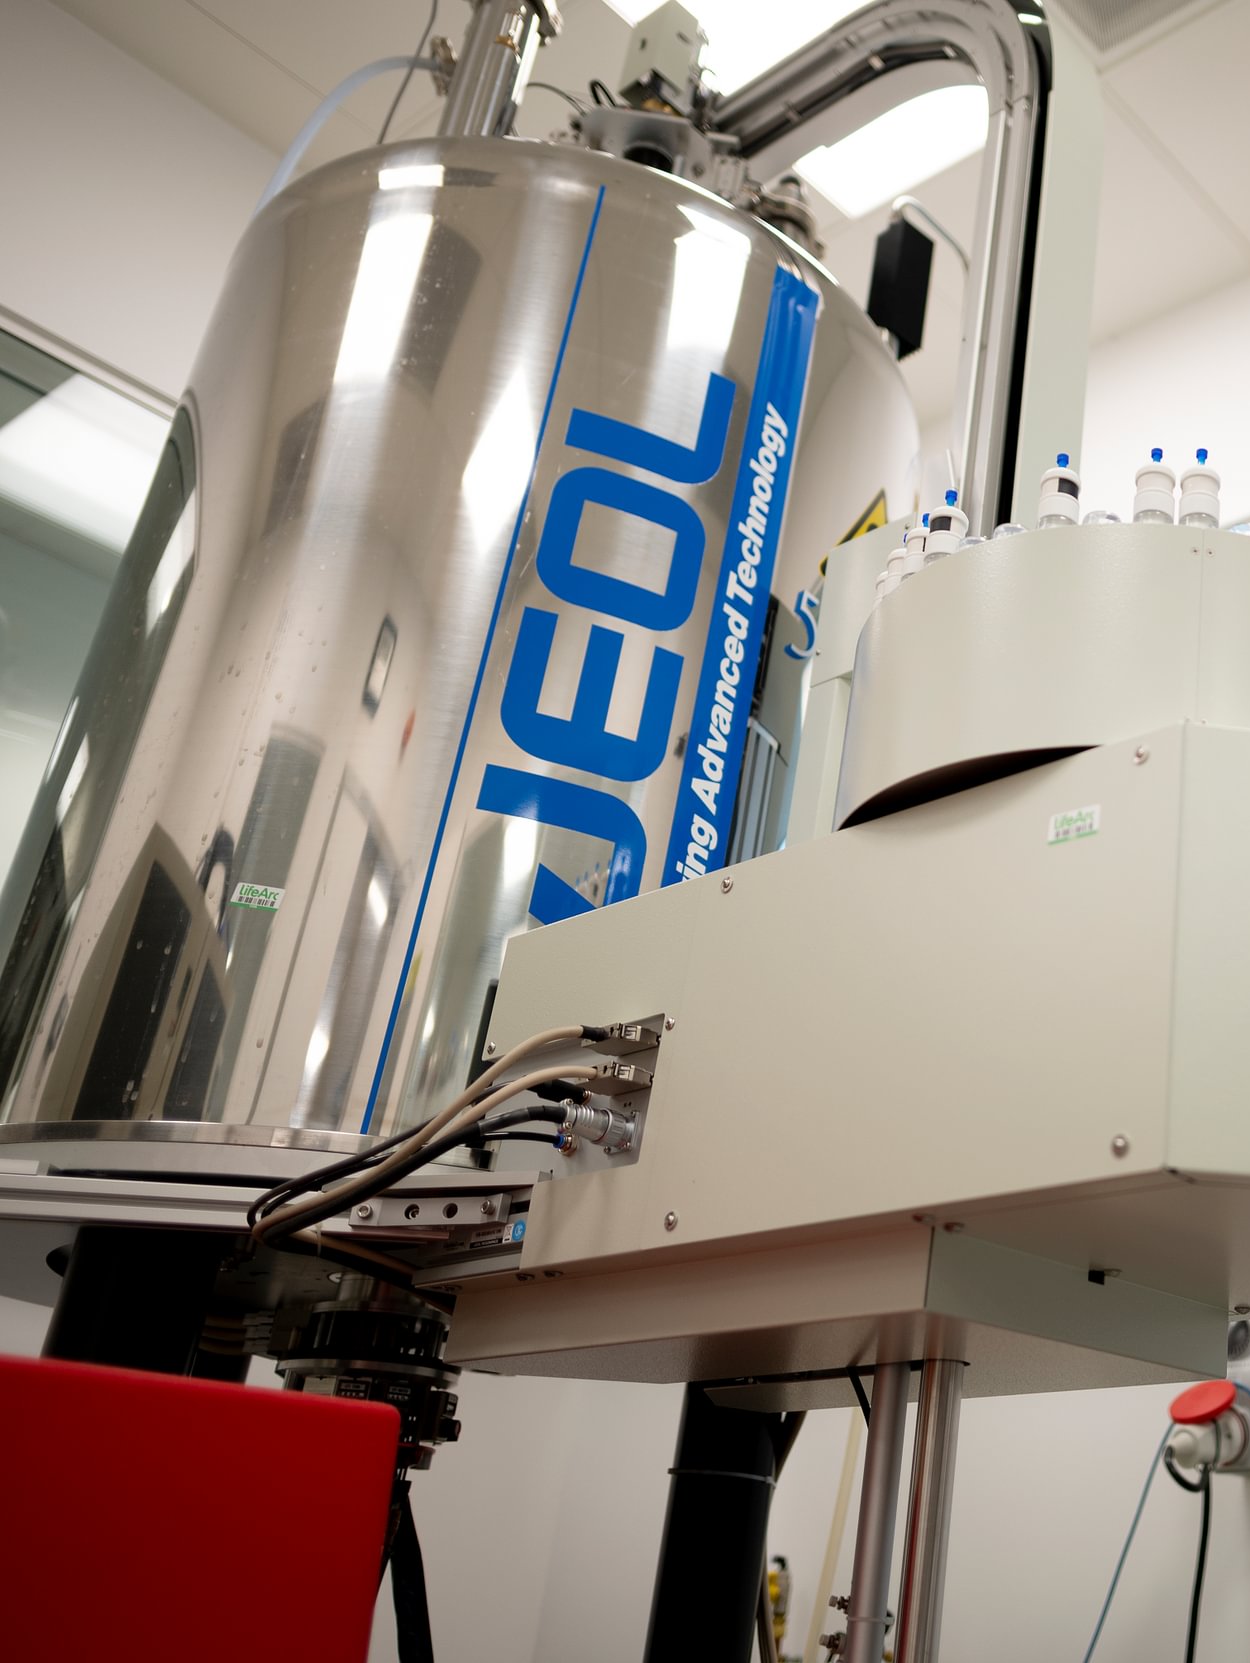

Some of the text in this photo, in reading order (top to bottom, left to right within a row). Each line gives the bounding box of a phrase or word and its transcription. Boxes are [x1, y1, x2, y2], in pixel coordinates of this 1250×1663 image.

[476, 371, 736, 926] JEOL
[675, 400, 789, 883] ing Advanced Technology
